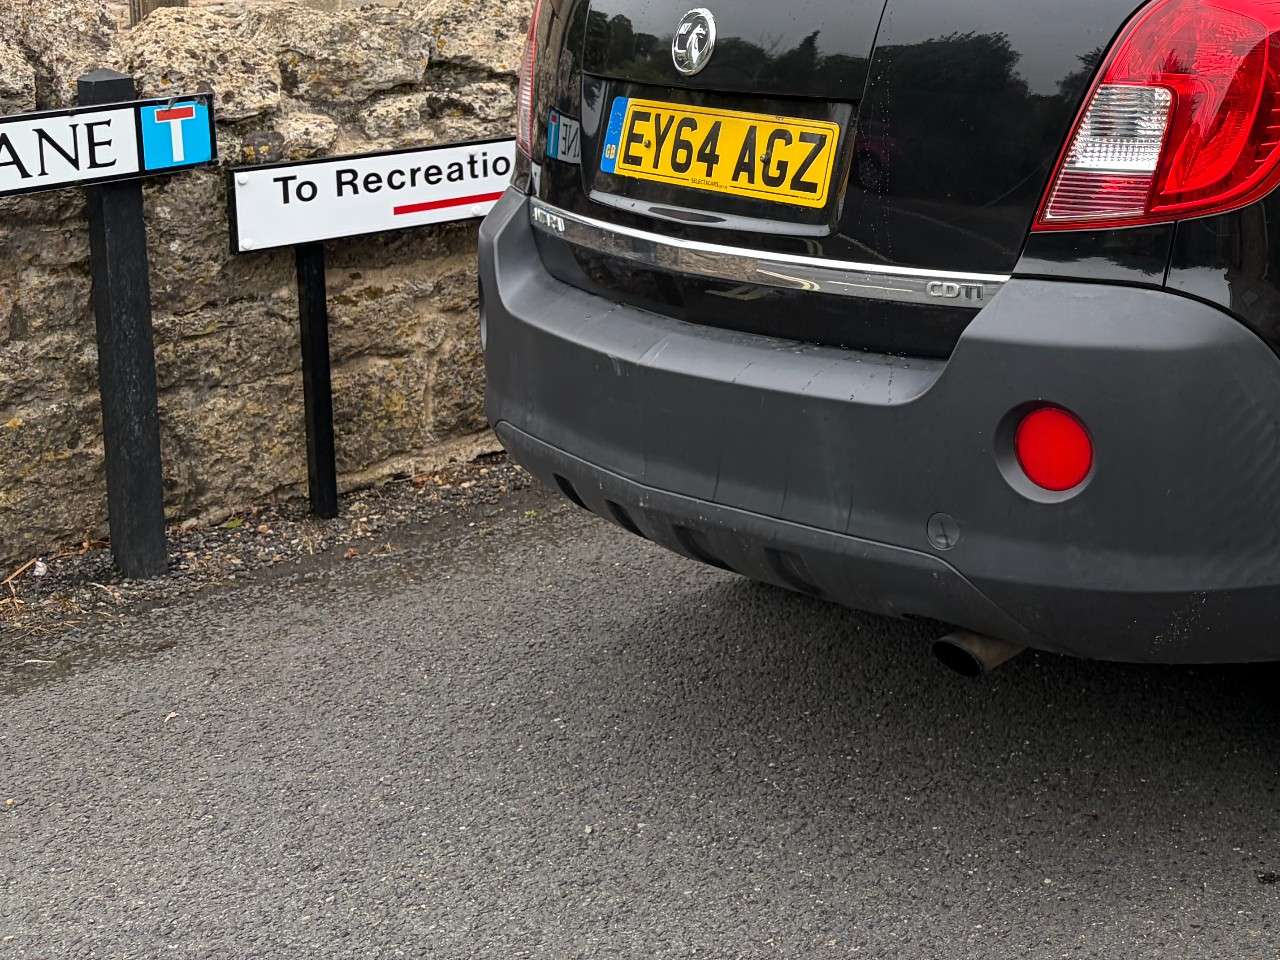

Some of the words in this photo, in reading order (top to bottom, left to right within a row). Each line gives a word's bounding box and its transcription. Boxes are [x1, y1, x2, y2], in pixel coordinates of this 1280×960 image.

[0, 119, 117, 179] ANE
[622, 110, 722, 178] EY64
[731, 125, 828, 194] AGZ
[273, 174, 318, 204] To
[335, 151, 511, 197] Recreatio
[926, 281, 984, 301] CDTI
